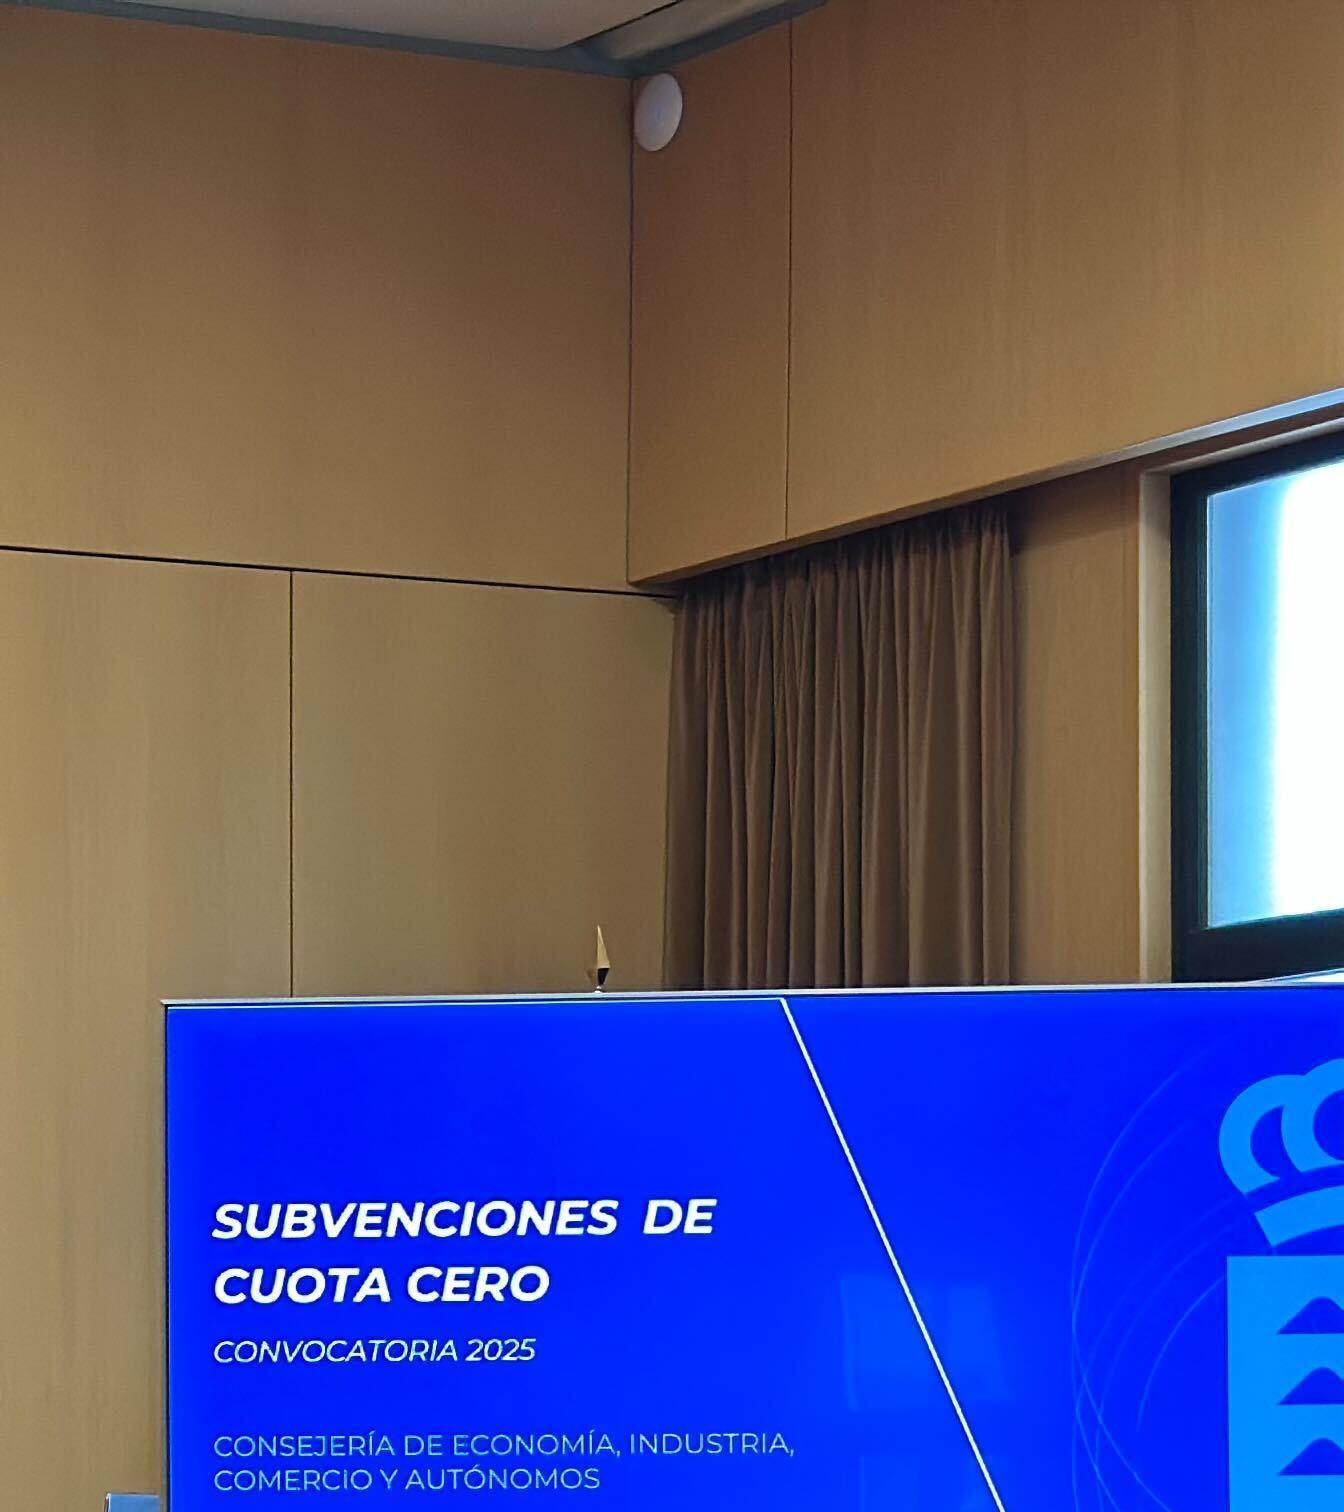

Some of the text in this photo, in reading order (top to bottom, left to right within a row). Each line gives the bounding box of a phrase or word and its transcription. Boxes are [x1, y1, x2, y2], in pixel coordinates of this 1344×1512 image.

[211, 1198, 718, 1240] SUBVENCIONES DE
[214, 1265, 550, 1305] CUOTA CERO
[213, 1338, 537, 1363] CONVOCATORIA 2025
[213, 1429, 795, 1458] CONSEJERÍA DE ECONOMÍA, INDUSTRIA,
[213, 1463, 601, 1492] COMERCIO Y AUTÓNOMOS
